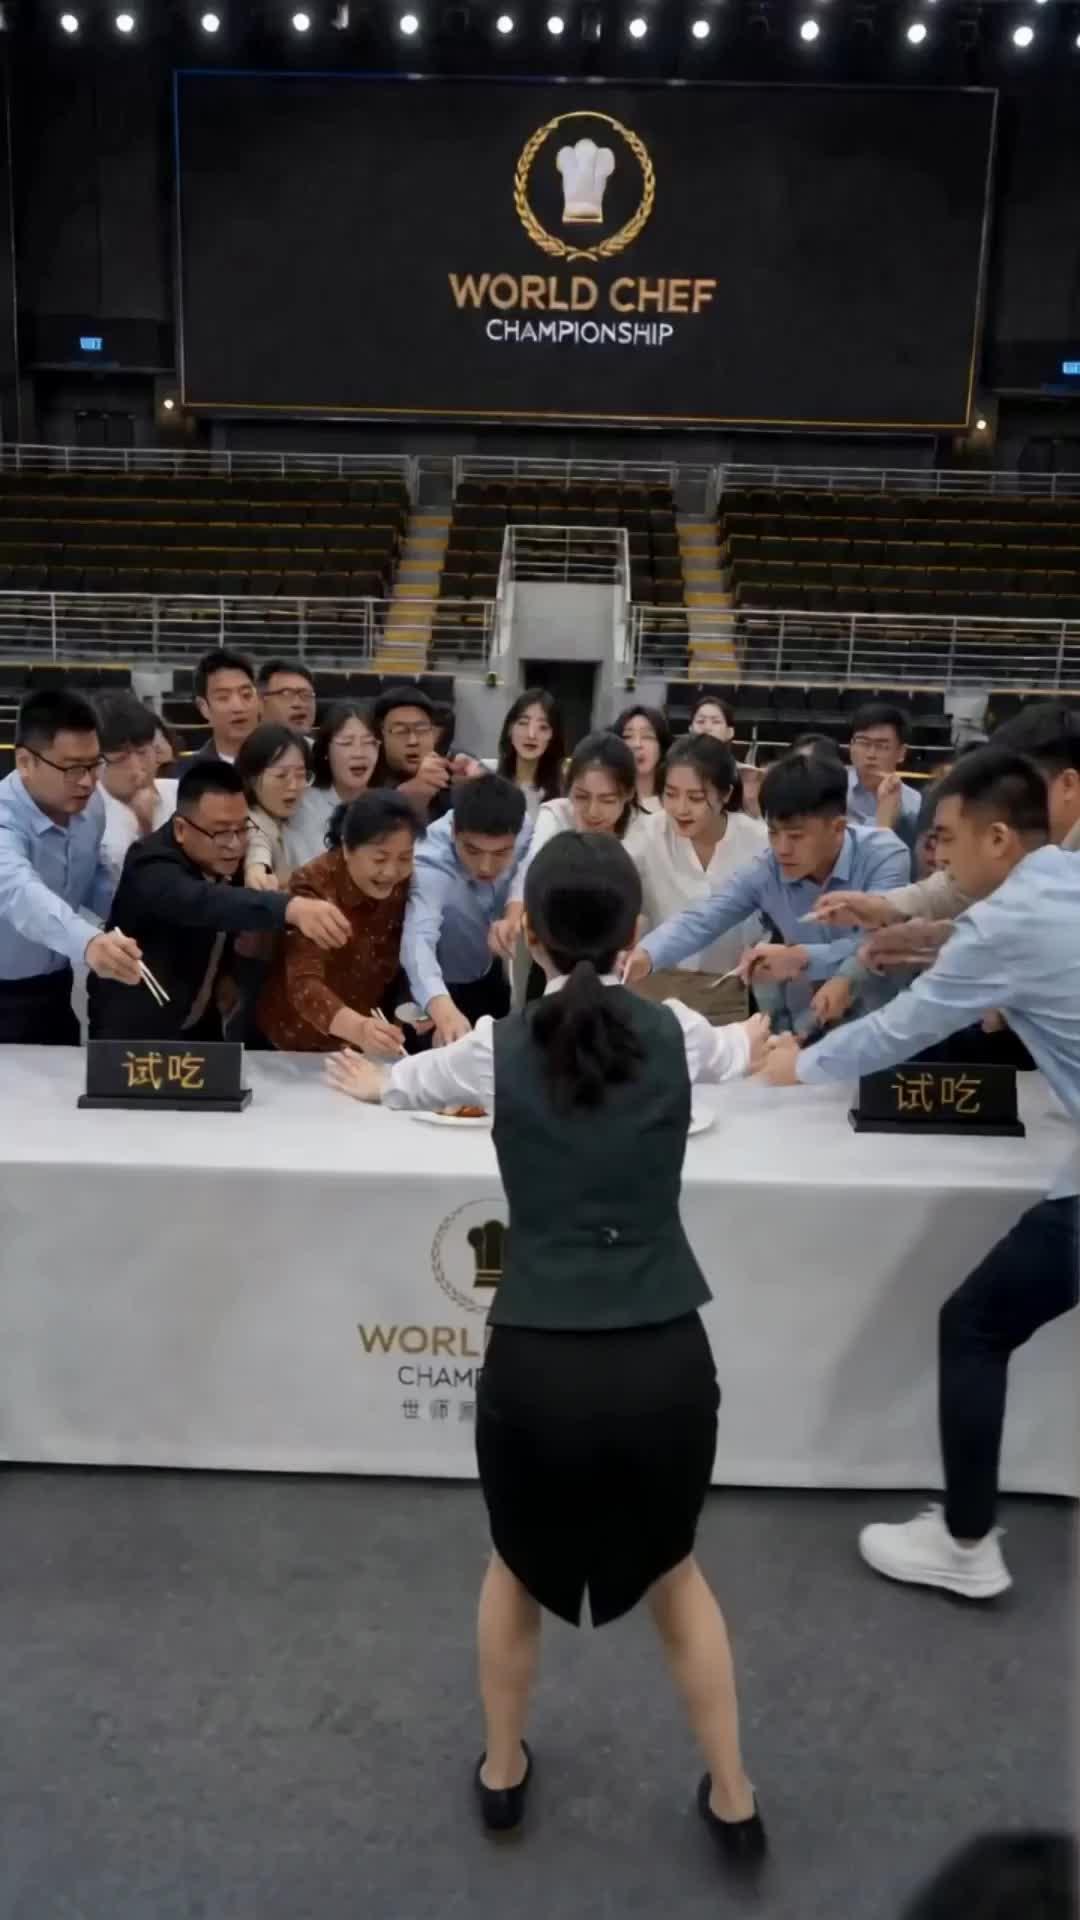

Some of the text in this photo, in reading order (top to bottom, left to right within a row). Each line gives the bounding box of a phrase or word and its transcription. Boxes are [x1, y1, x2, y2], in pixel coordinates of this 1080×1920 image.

[449, 273, 717, 313] WORLD CHEF
[486, 319, 674, 346] CHAMPIONSHIP
[121, 1051, 205, 1090] 试吃
[891, 1072, 982, 1113] 试吃
